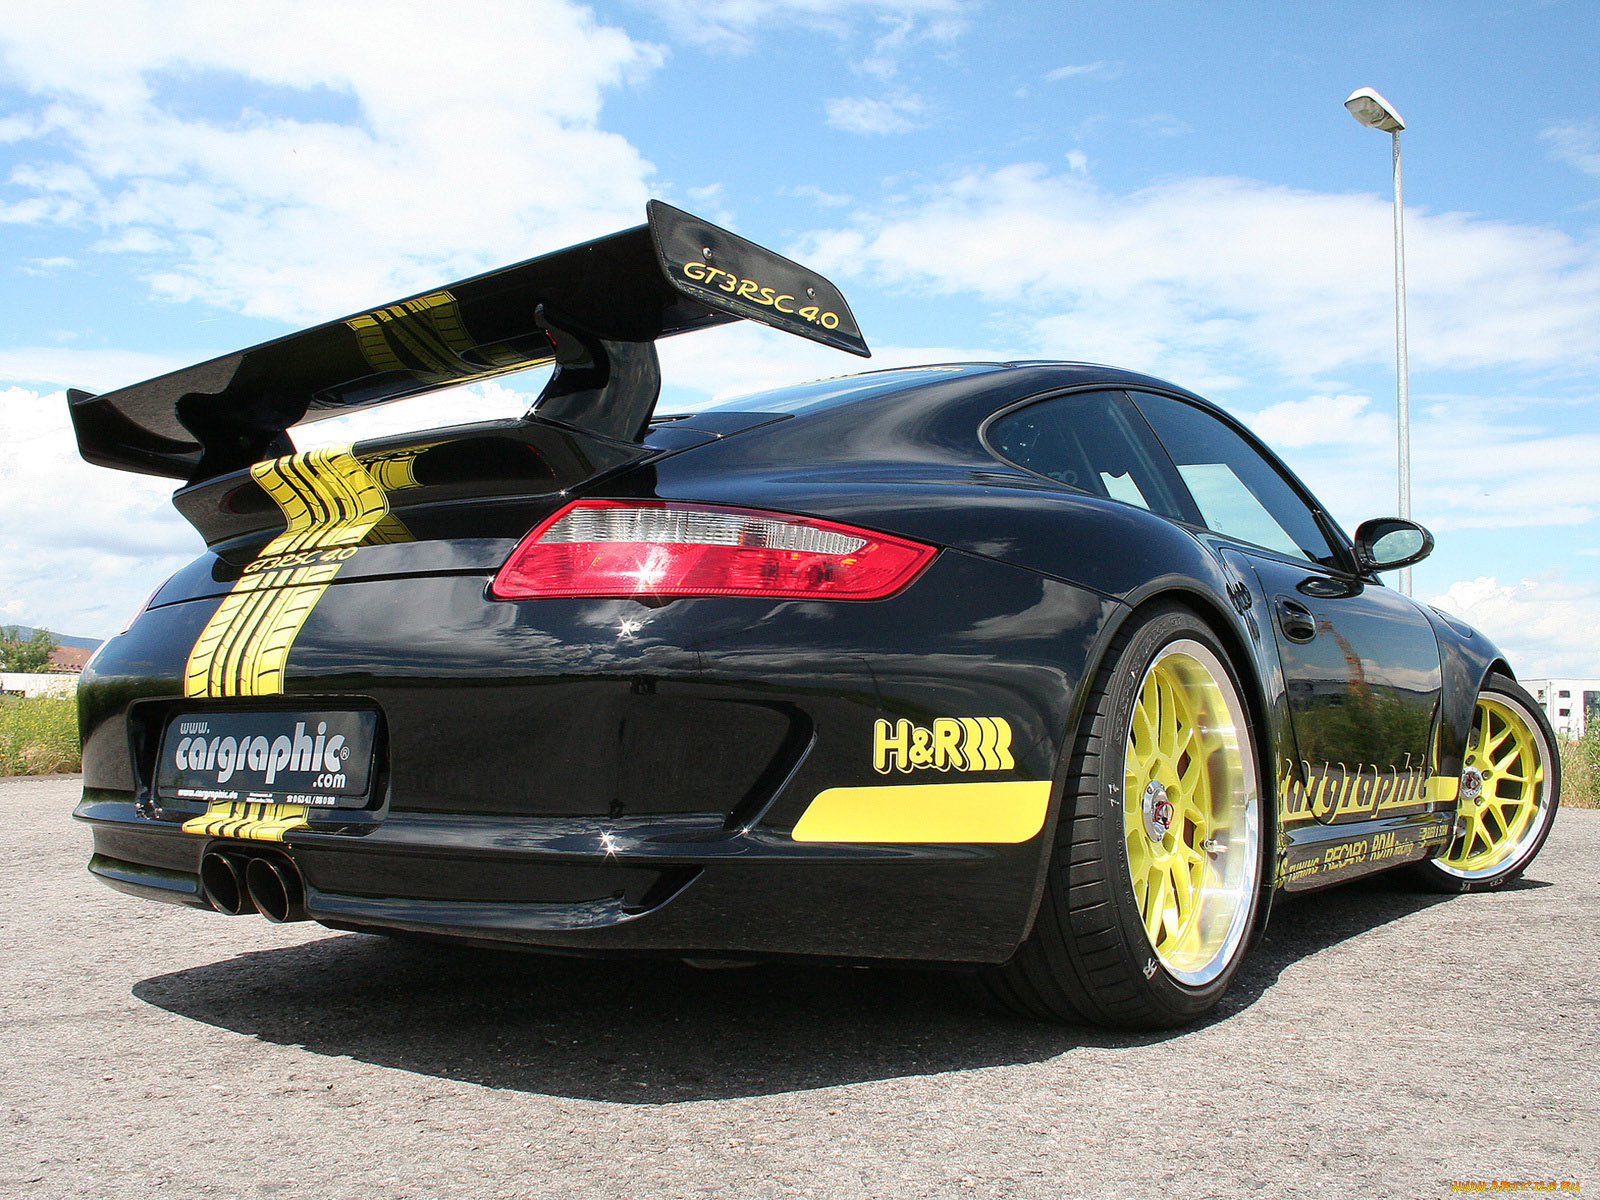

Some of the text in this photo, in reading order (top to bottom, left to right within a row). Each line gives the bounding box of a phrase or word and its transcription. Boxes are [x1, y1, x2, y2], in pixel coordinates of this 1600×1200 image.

[683, 261, 840, 330] GT3RSC 4.0
[873, 717, 970, 775] H&R
[312, 773, 346, 788] .com
